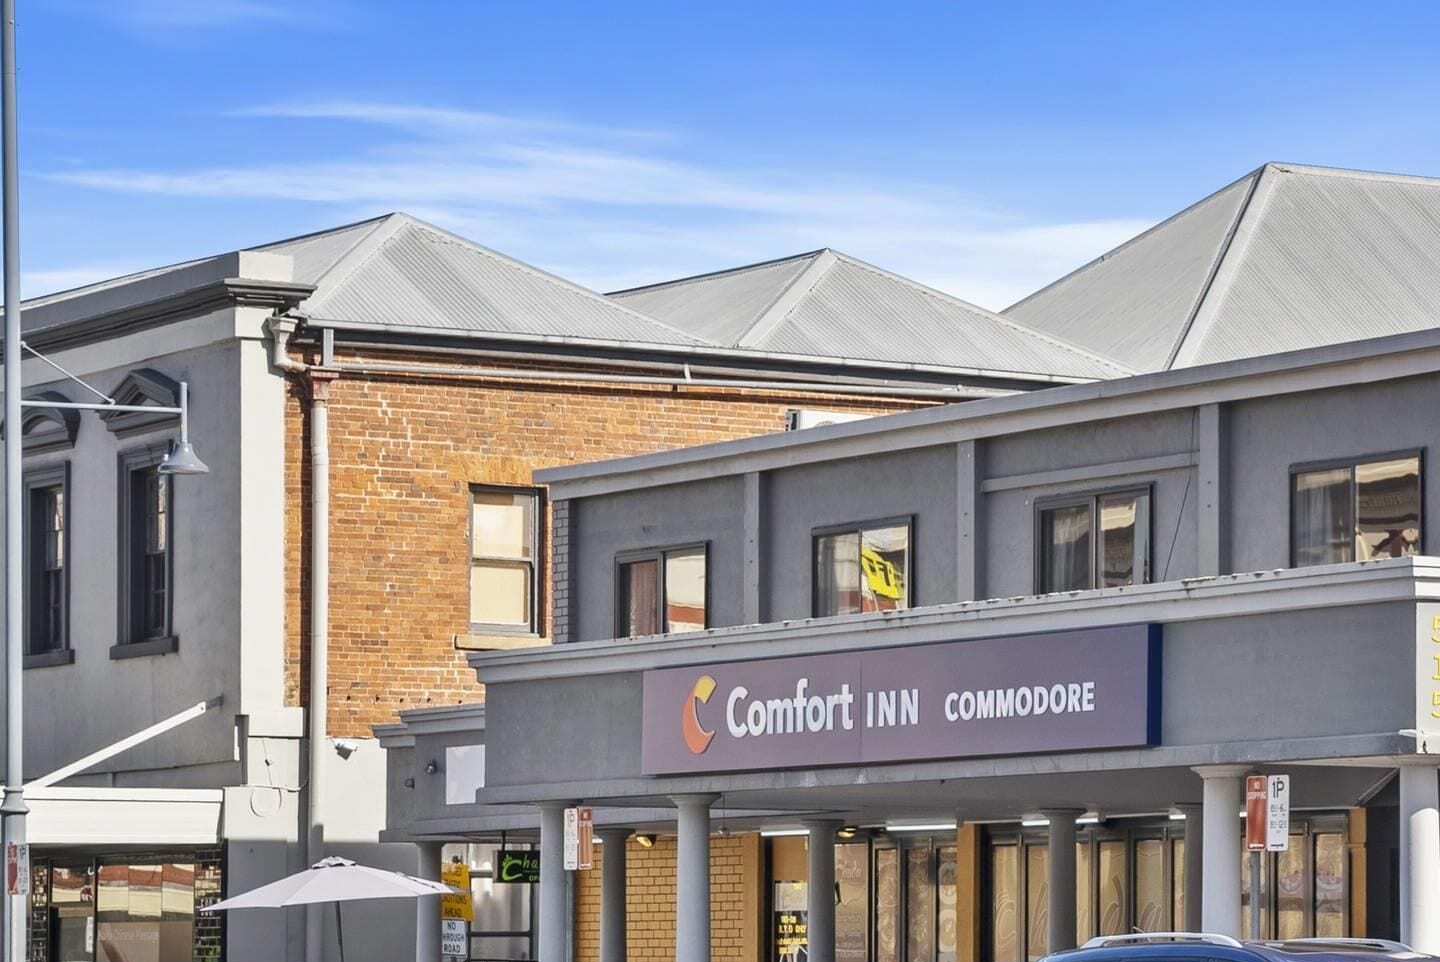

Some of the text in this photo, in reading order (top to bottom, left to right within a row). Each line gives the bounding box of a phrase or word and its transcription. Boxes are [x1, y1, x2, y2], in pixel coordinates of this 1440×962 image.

[726, 678, 1095, 738] Comfort INN COMMODORE
[1272, 779, 1285, 799] 1P
[447, 922, 456, 930] NO
[443, 933, 464, 942] HROUGH
[443, 944, 461, 953] ROAD
